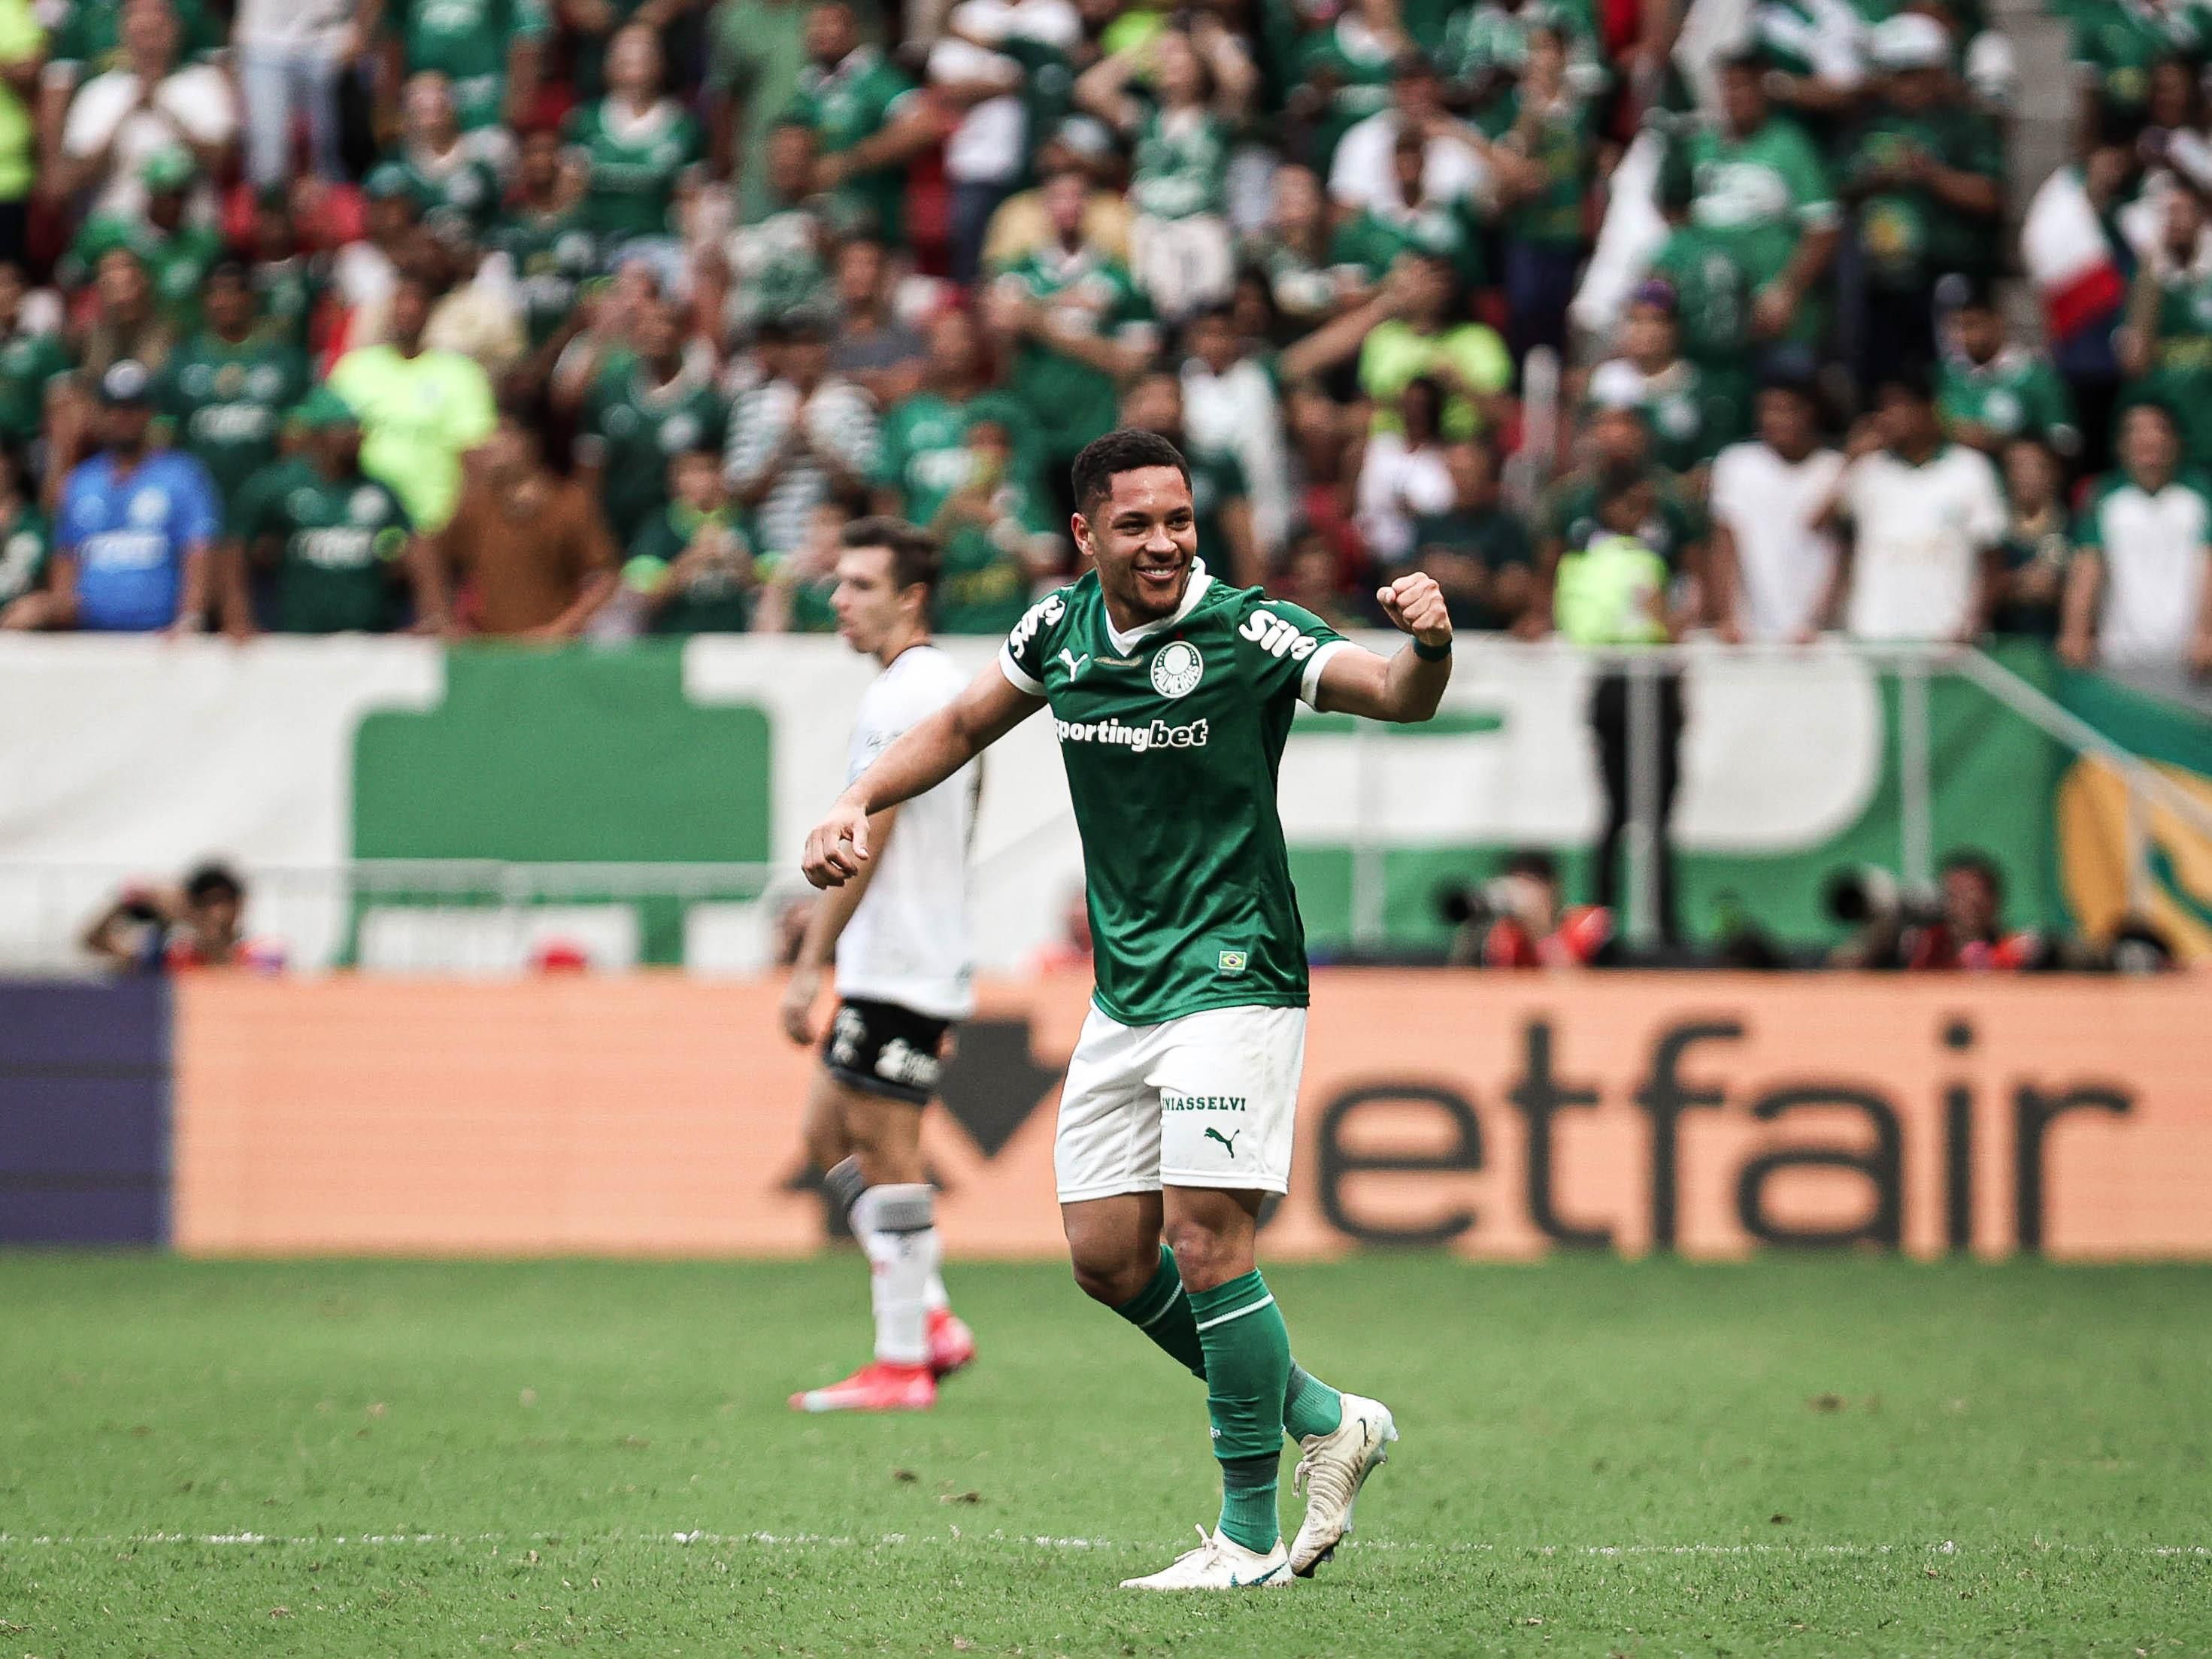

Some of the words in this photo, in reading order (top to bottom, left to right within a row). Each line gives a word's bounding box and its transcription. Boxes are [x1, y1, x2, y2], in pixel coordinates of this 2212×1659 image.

[1153, 663, 1200, 695] PALMEIRAS
[1162, 1096, 1247, 1112] NIASSELVI
[1257, 1011, 2135, 1257] etfair
